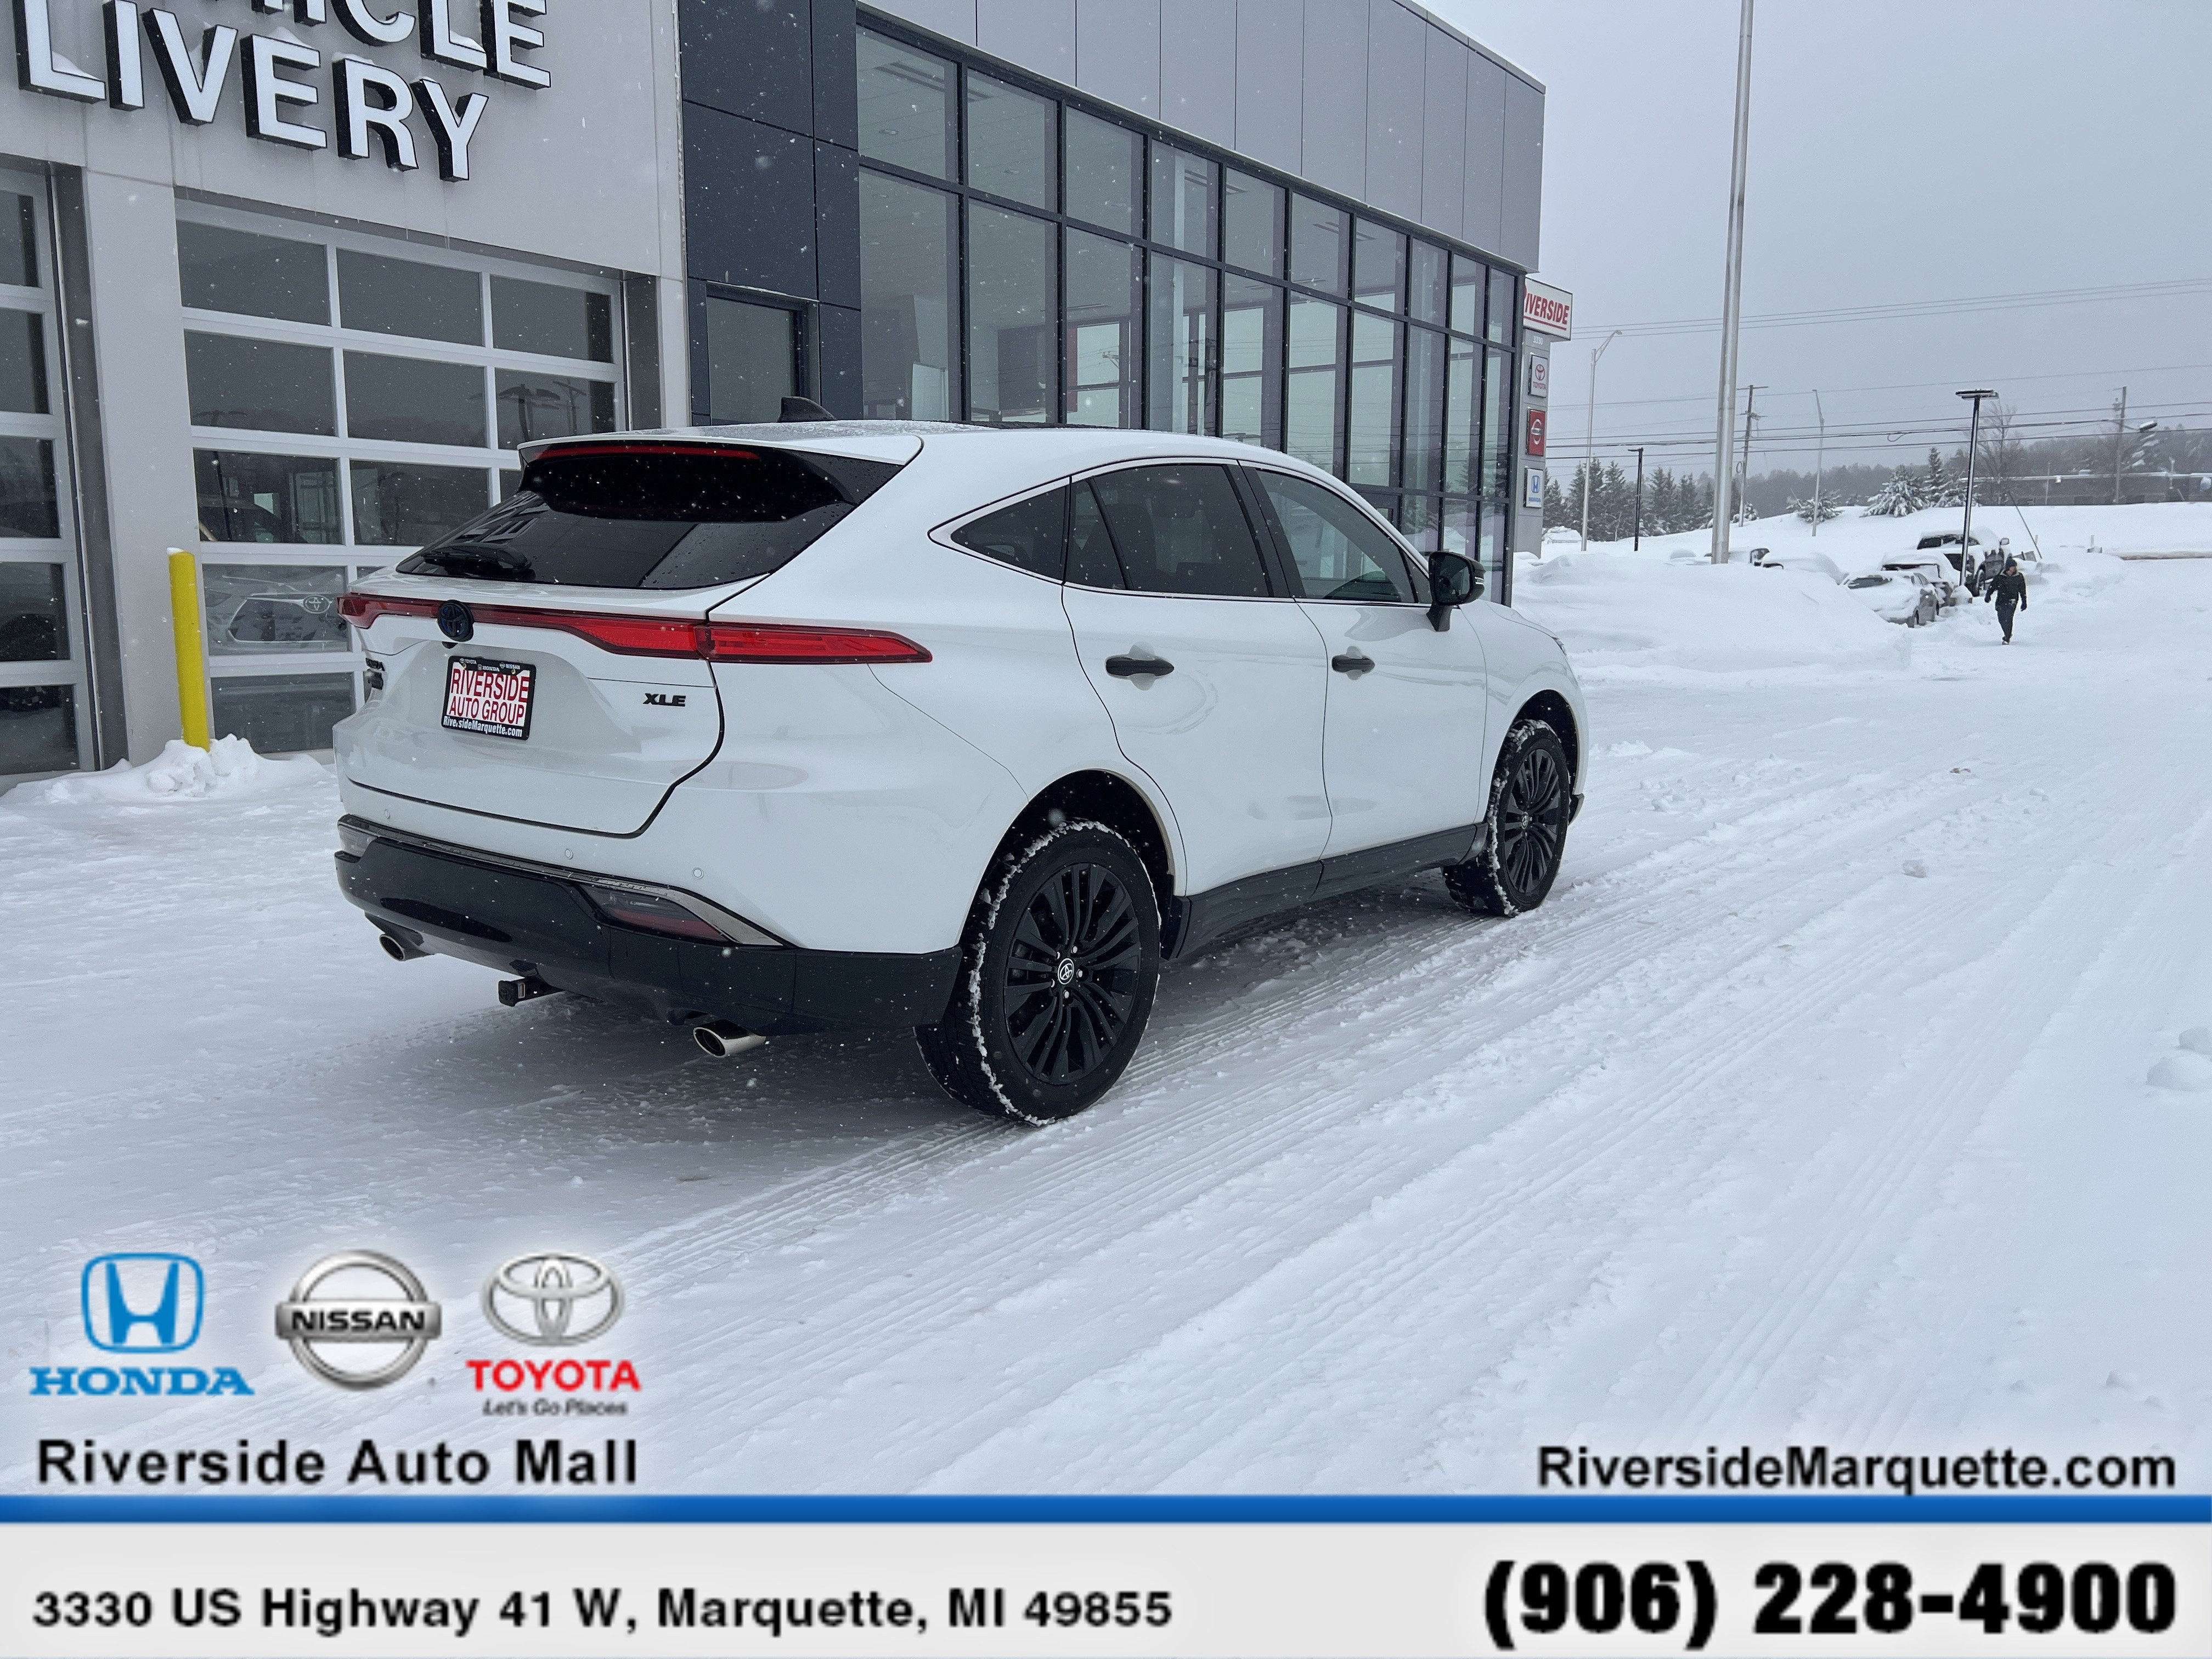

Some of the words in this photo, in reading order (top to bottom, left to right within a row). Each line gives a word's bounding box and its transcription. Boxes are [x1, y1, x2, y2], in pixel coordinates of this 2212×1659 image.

[1524, 290, 1570, 325] IVERSIDE
[451, 668, 531, 703] RIVERSIDE
[642, 693, 686, 707] XLE
[449, 696, 479, 718] AUTO
[482, 699, 524, 724] GROUP
